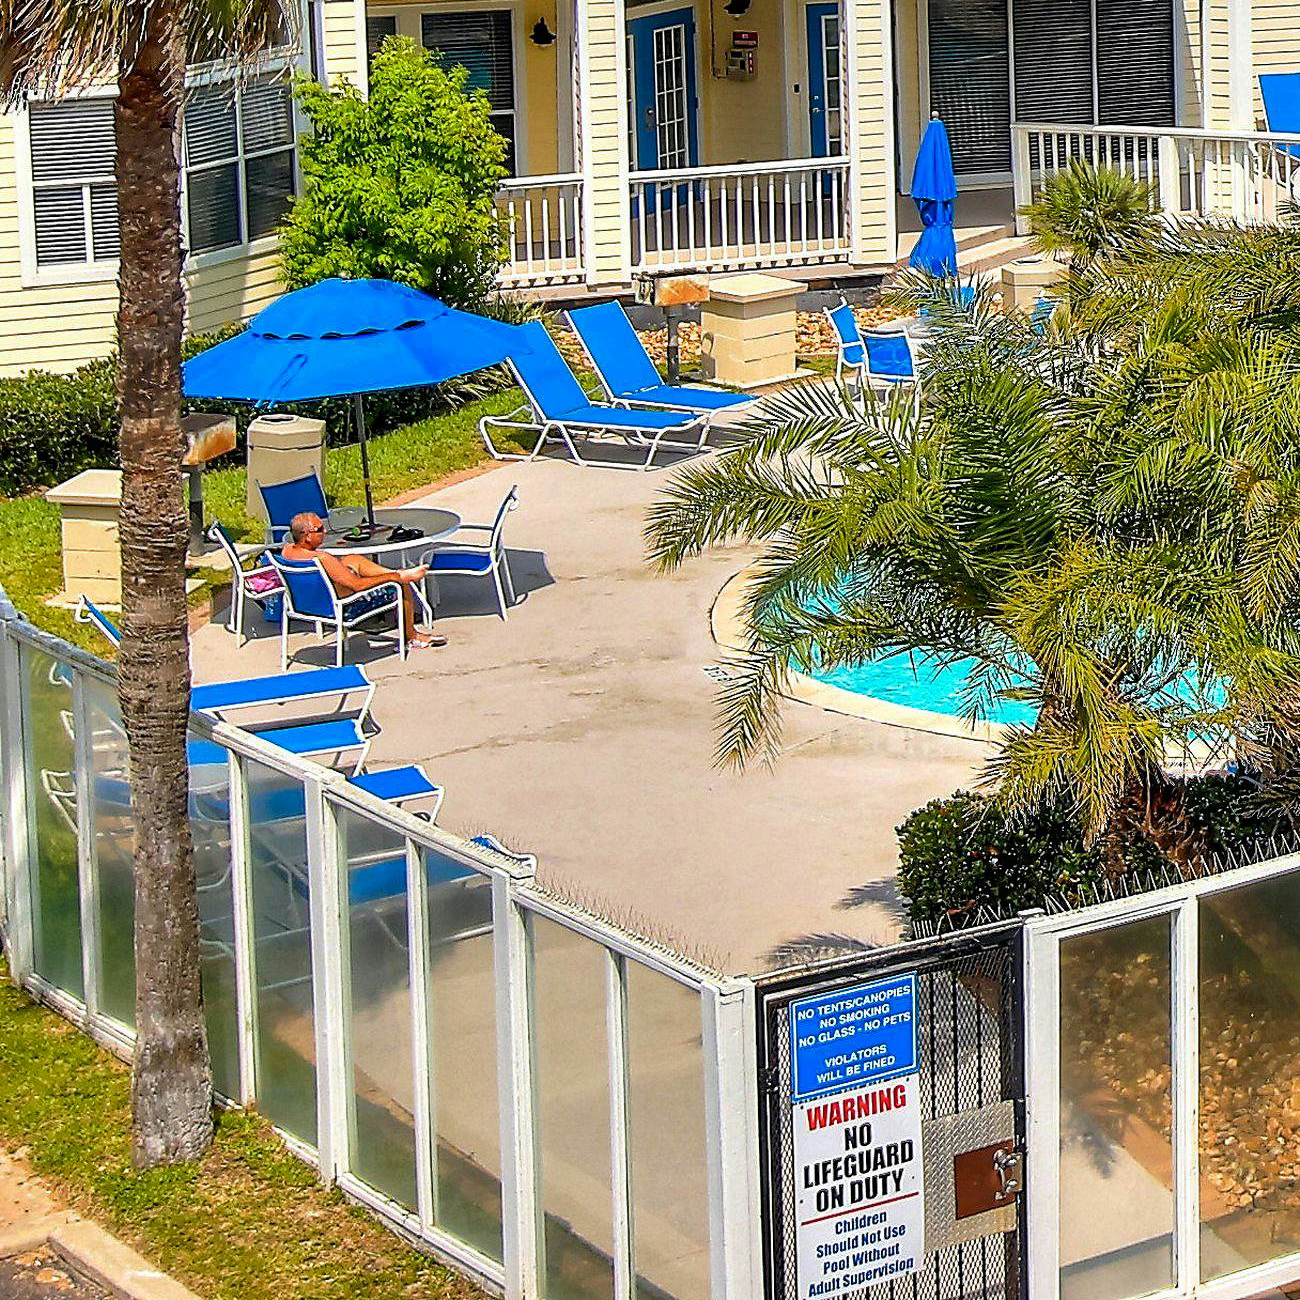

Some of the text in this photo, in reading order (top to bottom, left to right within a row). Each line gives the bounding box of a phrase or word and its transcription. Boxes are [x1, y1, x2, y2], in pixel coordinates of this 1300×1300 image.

[798, 985, 911, 1020] NO TENTS/CANOPIES
[820, 1004, 890, 1029] NO SMOKING
[799, 1036, 816, 1048] NO
[818, 1025, 856, 1043] GLASS
[864, 1019, 881, 1031] NO
[883, 1012, 911, 1027] PETS
[817, 1056, 896, 1083] WILL BE FINED
[825, 1044, 887, 1067] VIOLATORS
[807, 1084, 907, 1131] WARNING
[844, 1122, 872, 1151] NO
[804, 1139, 914, 1189] LIFEGUARD
[816, 1168, 904, 1212] ON DUTY
[835, 1211, 887, 1235] Children
[816, 1224, 906, 1258] Should Not Use
[823, 1243, 900, 1275] Pool Without
[808, 1257, 914, 1298] Adult Supervision
